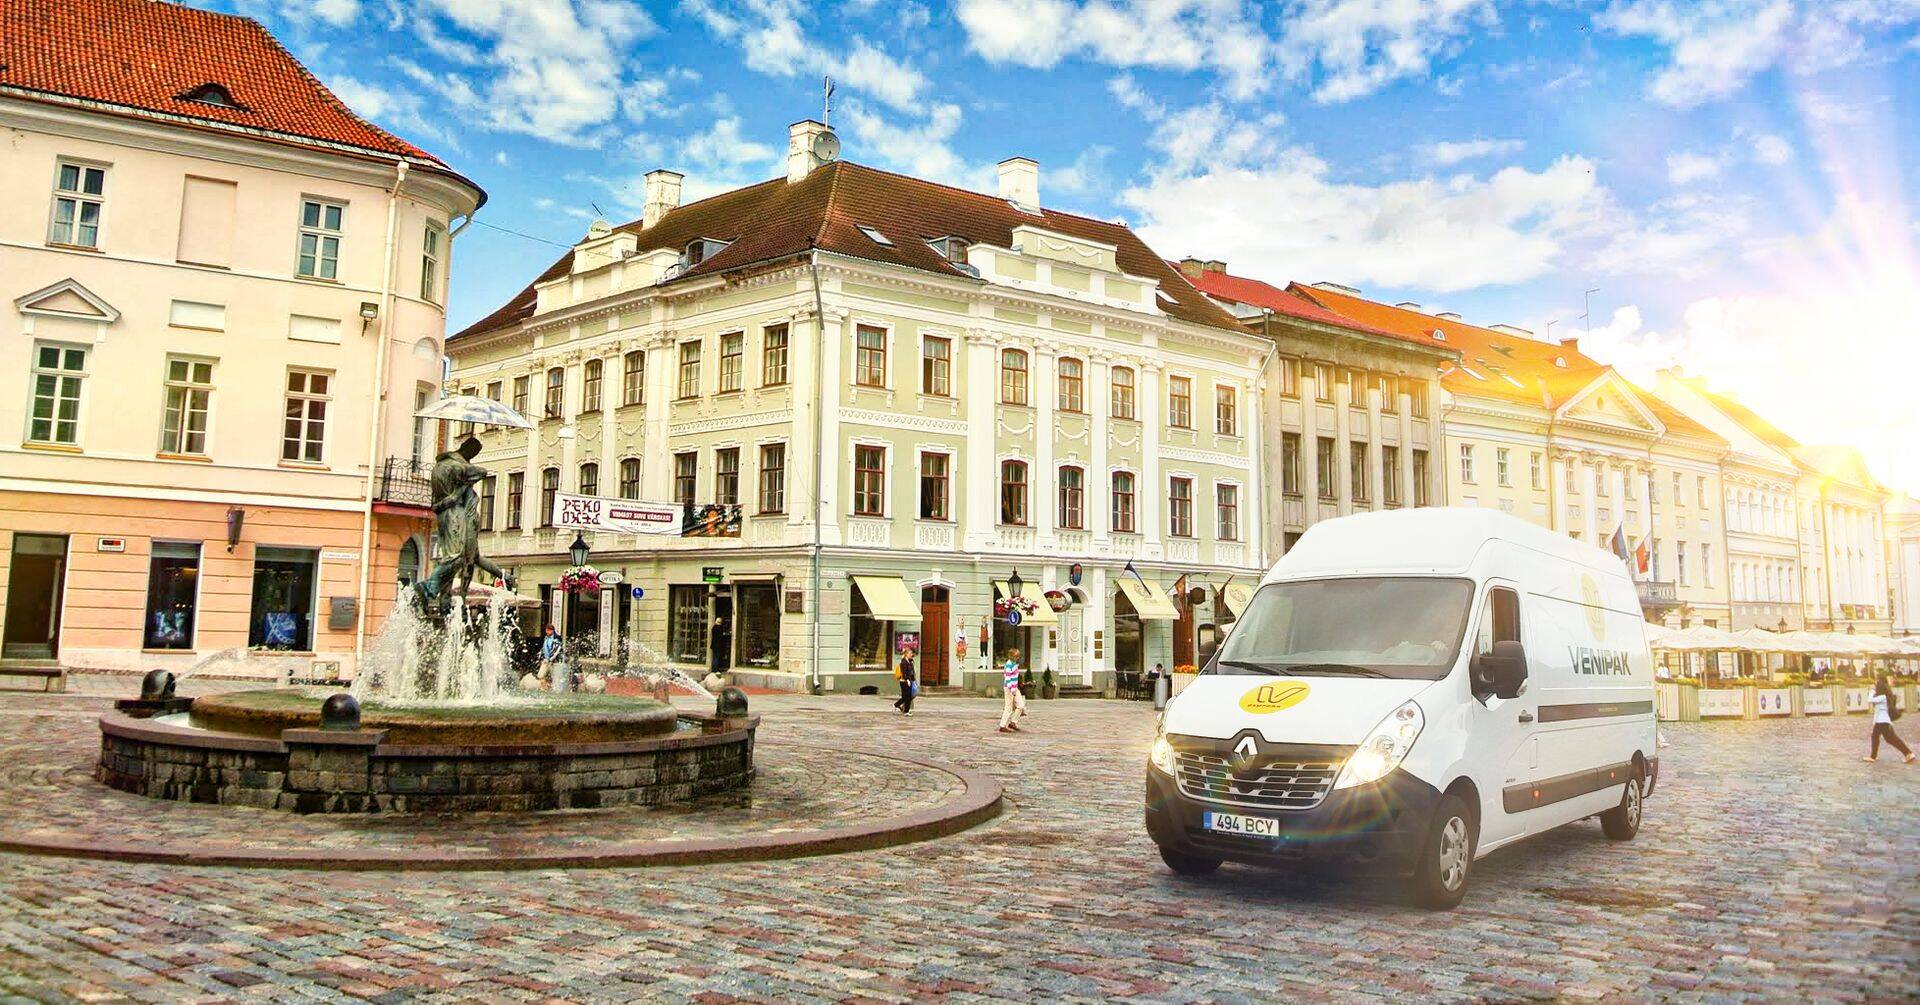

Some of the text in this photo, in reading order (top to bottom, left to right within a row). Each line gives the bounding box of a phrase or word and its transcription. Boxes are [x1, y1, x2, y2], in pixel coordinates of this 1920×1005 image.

[562, 499, 600, 513] PEKO
[1568, 645, 1632, 676] VENIPAK
[1216, 815, 1274, 834] 494 BCY
